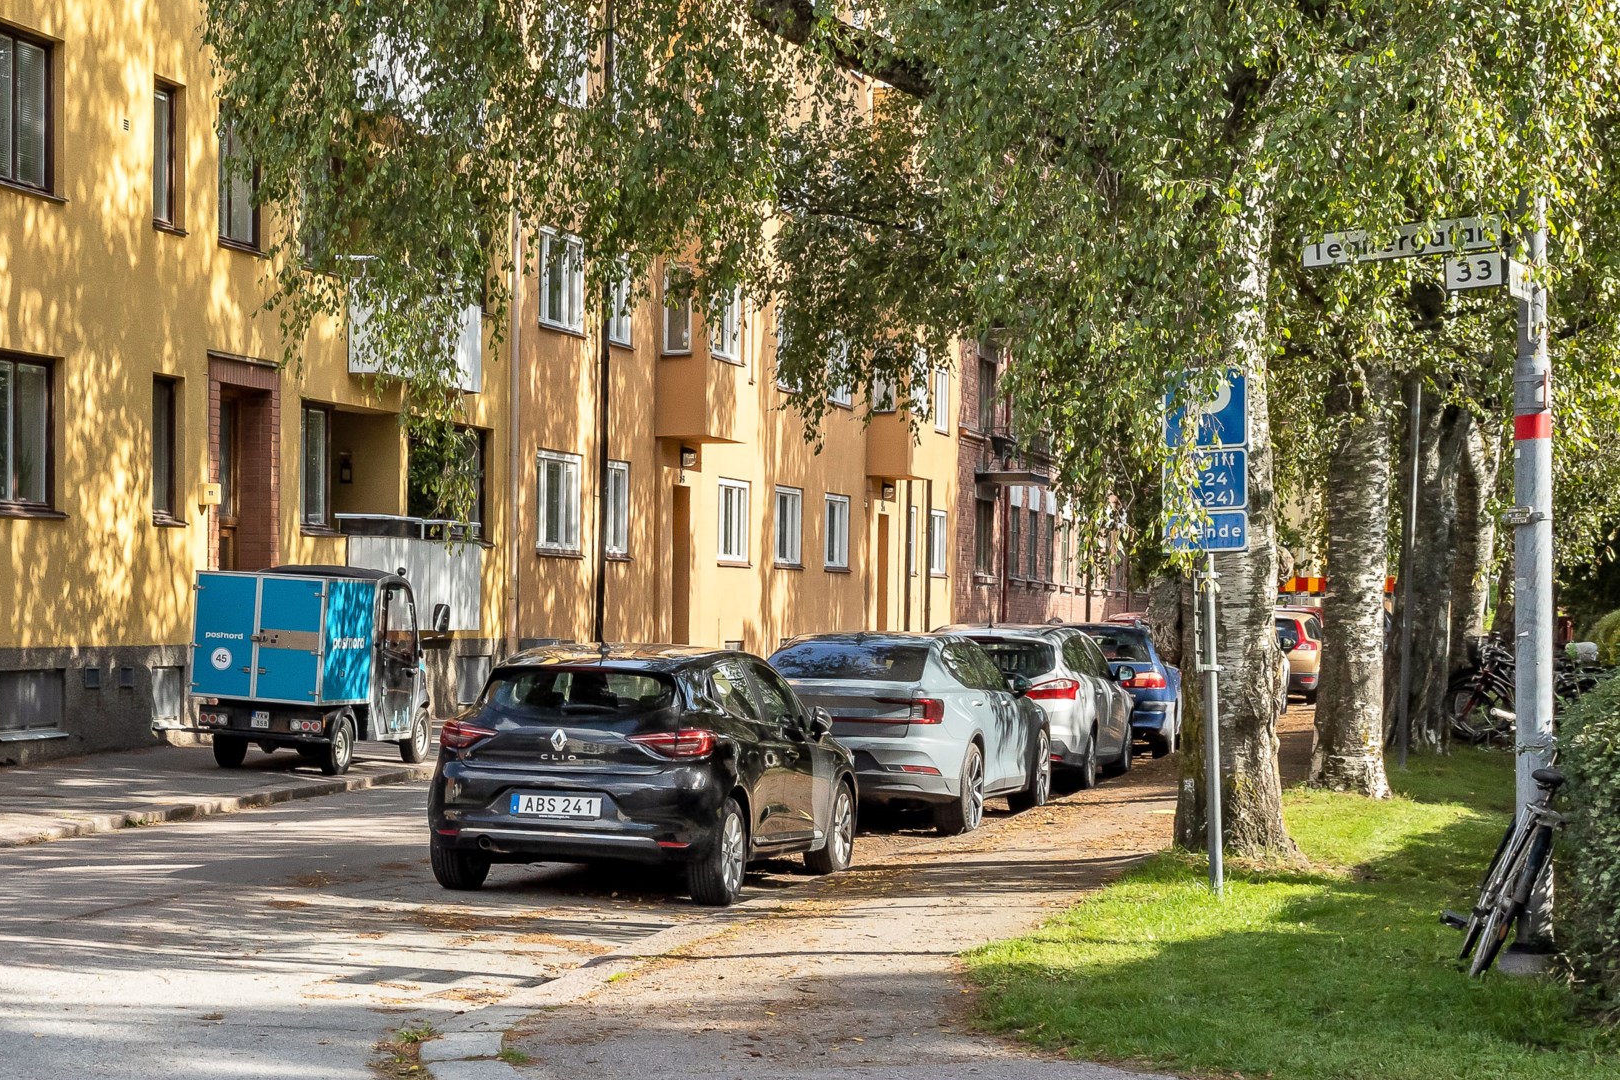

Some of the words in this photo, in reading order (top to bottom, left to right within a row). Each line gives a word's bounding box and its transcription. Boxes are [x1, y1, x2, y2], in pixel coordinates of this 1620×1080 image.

[1455, 259, 1493, 282] 33
[205, 631, 244, 640] postnord
[215, 653, 228, 663] 45
[524, 797, 556, 813] ABS
[561, 798, 593, 814] 241
